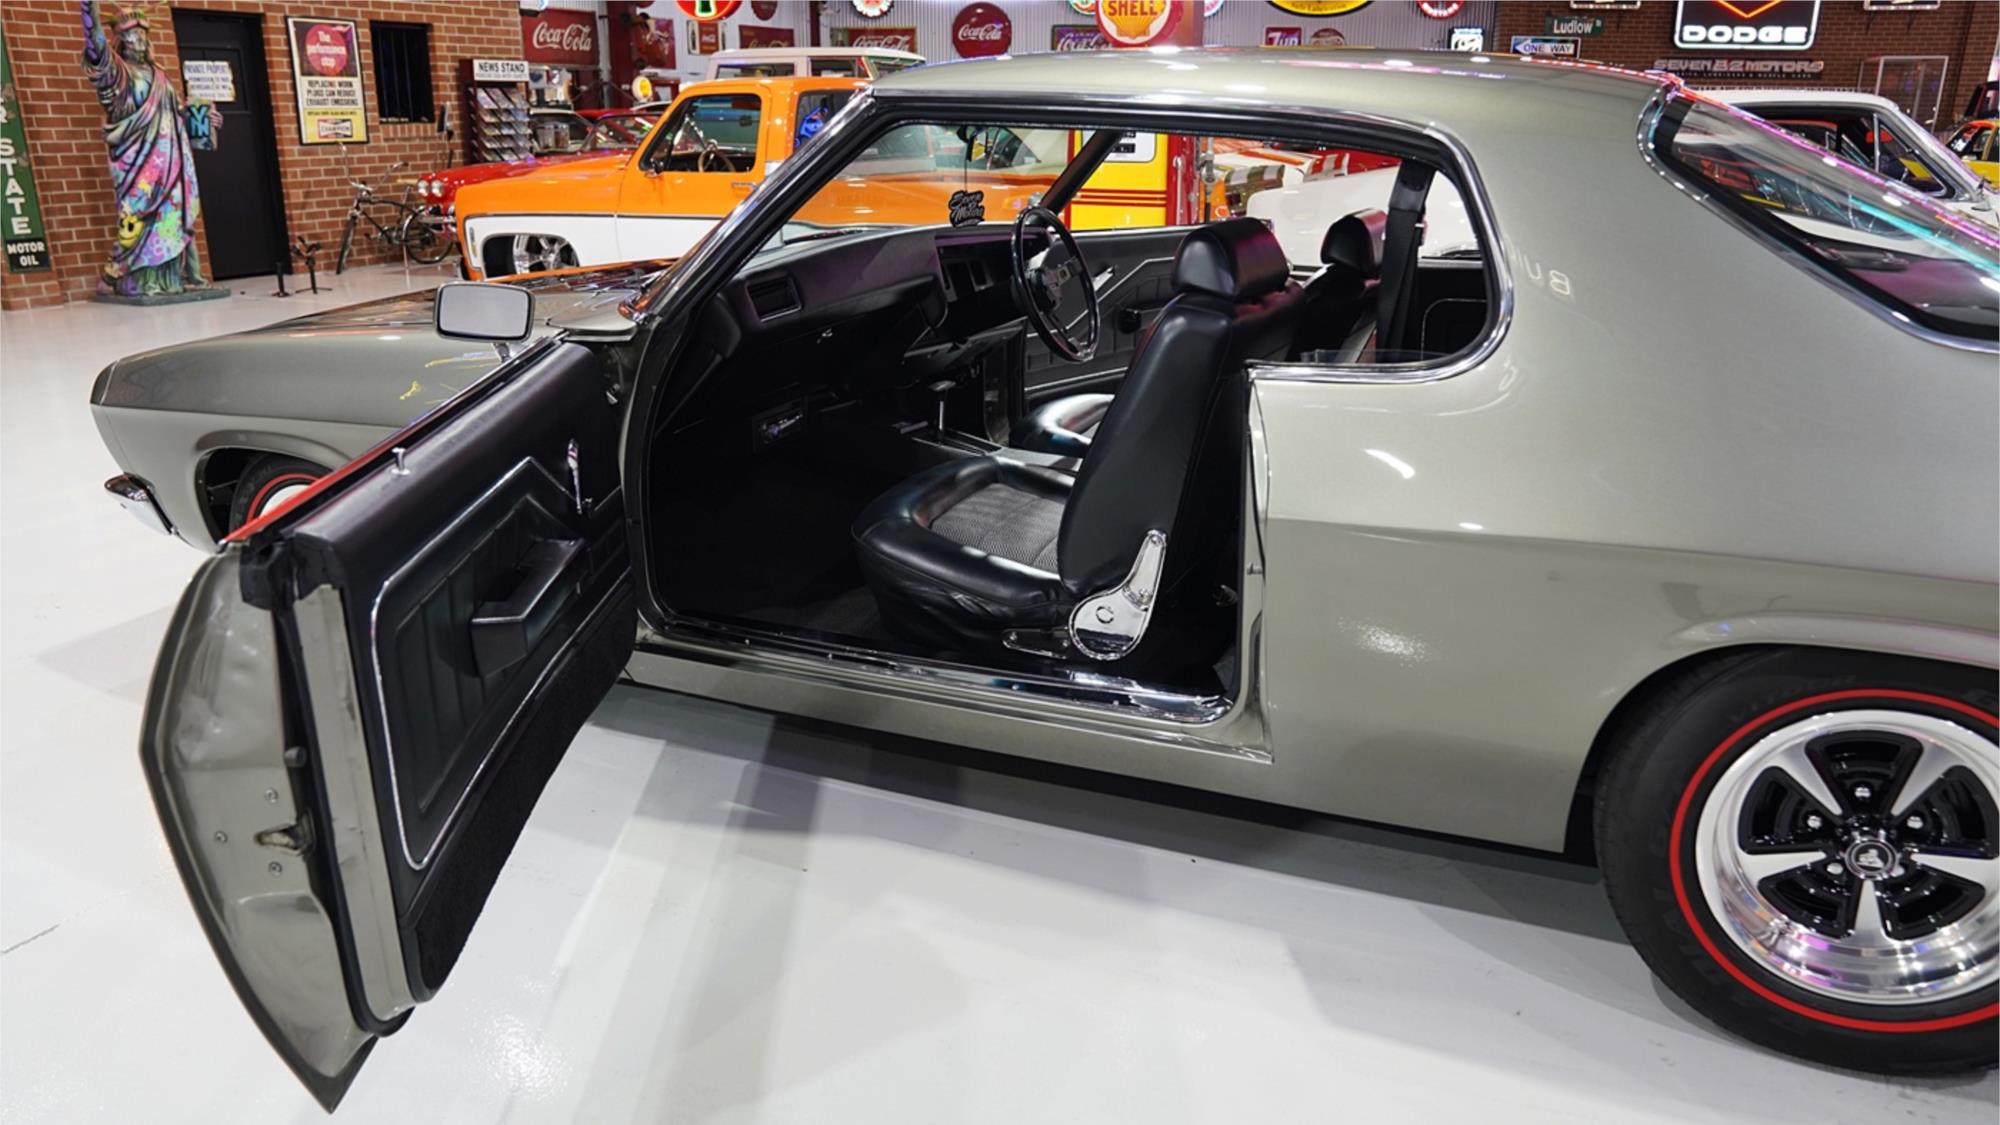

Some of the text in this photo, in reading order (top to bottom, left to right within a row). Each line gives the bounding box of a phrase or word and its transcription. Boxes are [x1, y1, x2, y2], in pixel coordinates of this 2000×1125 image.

[1108, 0, 1158, 17] SHELL
[958, 23, 1003, 41] Coca-Cola
[1553, 19, 1593, 34] Ludlow
[1682, 25, 1808, 43] DODGE
[532, 21, 592, 52] Coca-Cola
[1524, 43, 1572, 54] ONE WAY
[478, 62, 525, 74] NEWS STAND
[0, 138, 32, 235] STATE
[6, 241, 45, 255] MOTOR
[19, 255, 39, 267] OIL
